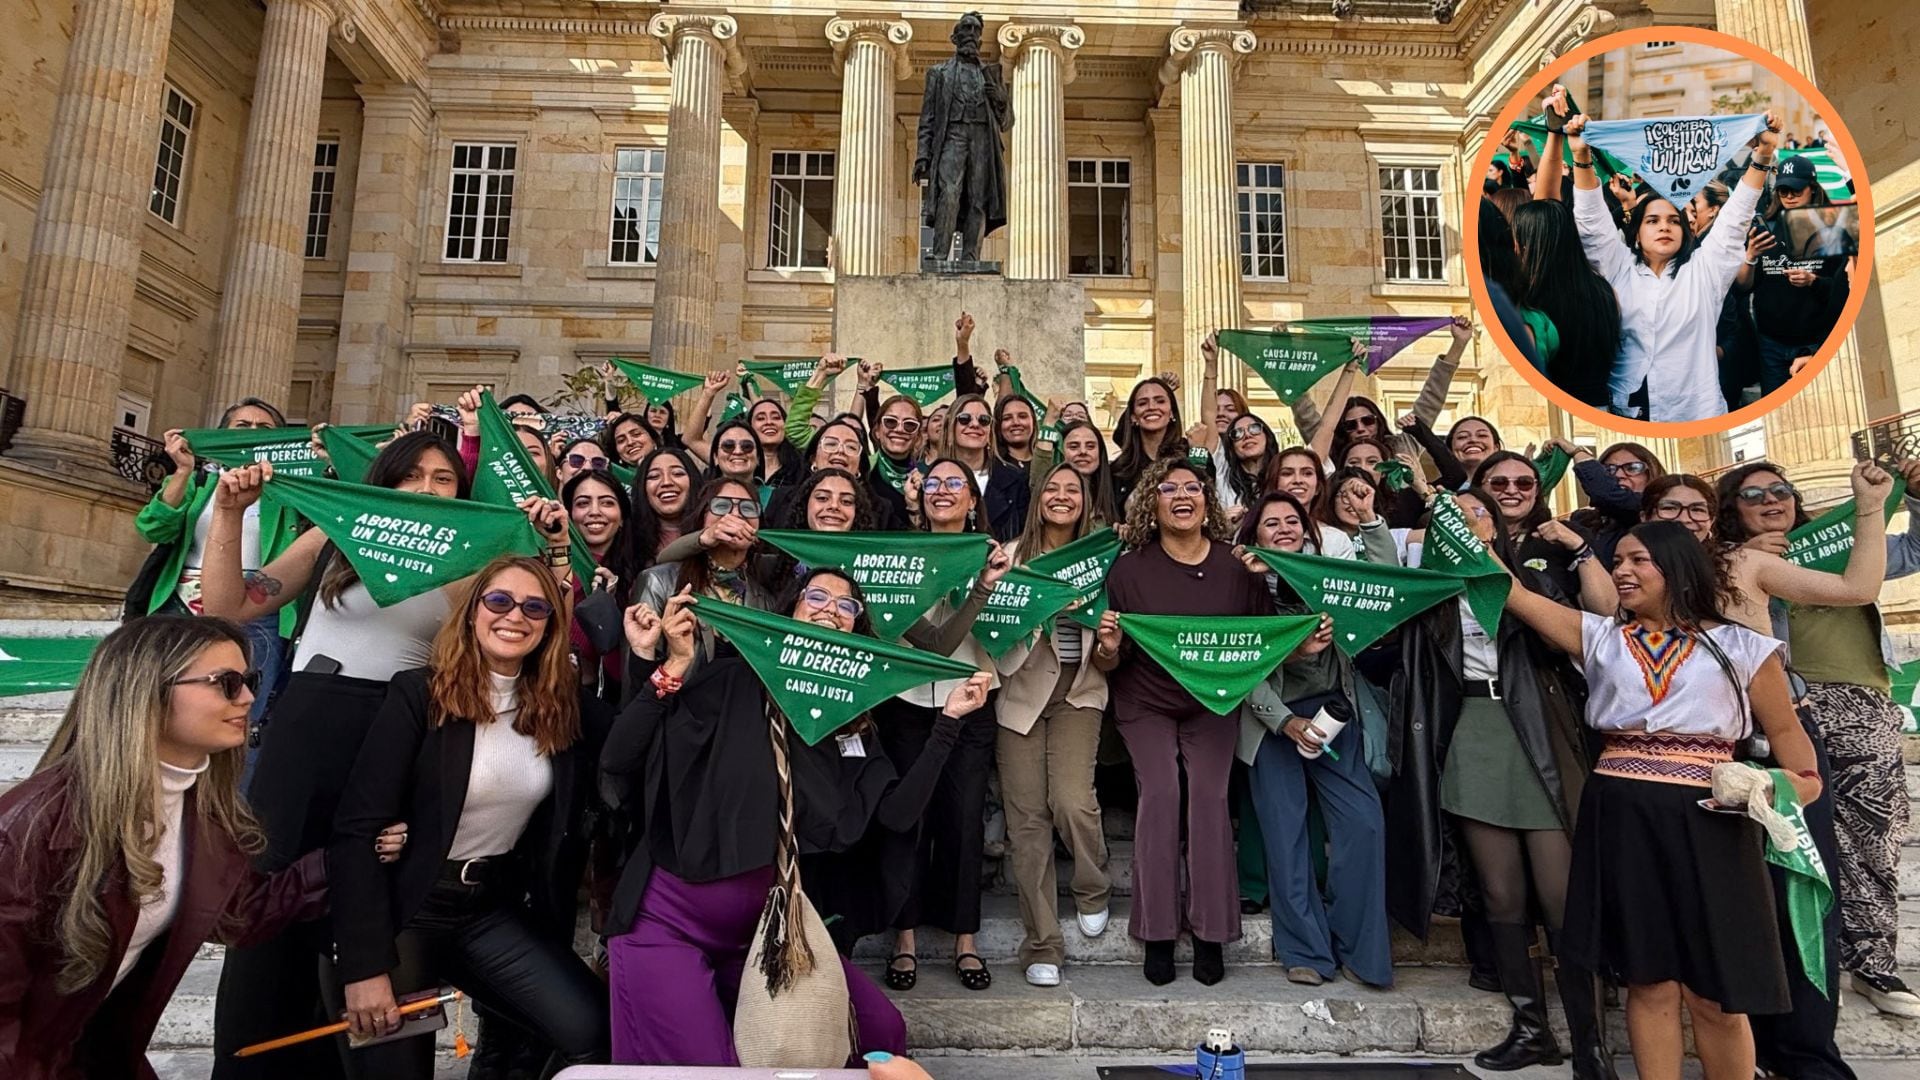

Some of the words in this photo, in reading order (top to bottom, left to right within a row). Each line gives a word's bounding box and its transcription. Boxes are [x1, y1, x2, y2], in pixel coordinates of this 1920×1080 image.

[1655, 132, 1680, 150] TUS
[1674, 127, 1712, 153] HIJOS
[1263, 349, 1290, 359] CAUSA
[1291, 350, 1318, 361] JUSTA
[1264, 361, 1277, 369] POR
[1288, 362, 1317, 372] ABORTO
[254, 451, 269, 462] UN
[488, 461, 507, 477] POR
[502, 451, 532, 488] CAUSA
[355, 513, 432, 537] ABORTAR
[434, 527, 457, 542] ES
[1812, 522, 1851, 544] JUSTA
[351, 525, 376, 541] UN
[377, 532, 452, 556] DERECHO
[1803, 551, 1816, 563] EL
[1818, 536, 1855, 559] ABORTO
[358, 547, 395, 564] CAUSA
[397, 557, 433, 575] JUSTA
[853, 554, 907, 569] ABORTAR
[909, 556, 925, 570] ES
[1087, 557, 1098, 568] ES
[1438, 541, 1462, 565] JUSTA
[853, 570, 869, 583] UN
[871, 570, 924, 585] DERECHO
[966, 577, 1014, 594] ATAR
[1016, 585, 1032, 596] ES
[1069, 567, 1103, 588] ERECHO
[1323, 577, 1357, 593] CAUSA
[1360, 582, 1395, 598] JUSTA
[863, 593, 888, 604] AUSA
[889, 594, 916, 605] JUSTA
[987, 593, 1029, 607] ERECHO
[1322, 593, 1339, 605] POR
[1342, 595, 1352, 607] EL
[1354, 597, 1392, 612] ABORTO
[996, 613, 1020, 625] JUSTA
[1178, 632, 1218, 645] CAUSA
[1221, 633, 1262, 646] JUSTA
[780, 647, 801, 666] UN
[802, 652, 871, 679] DERECHO
[1180, 650, 1199, 661] POR
[1203, 650, 1214, 662] EL
[1218, 650, 1262, 662] ABORTO
[785, 679, 819, 696] CAUSA
[820, 685, 854, 703] JUSTA
